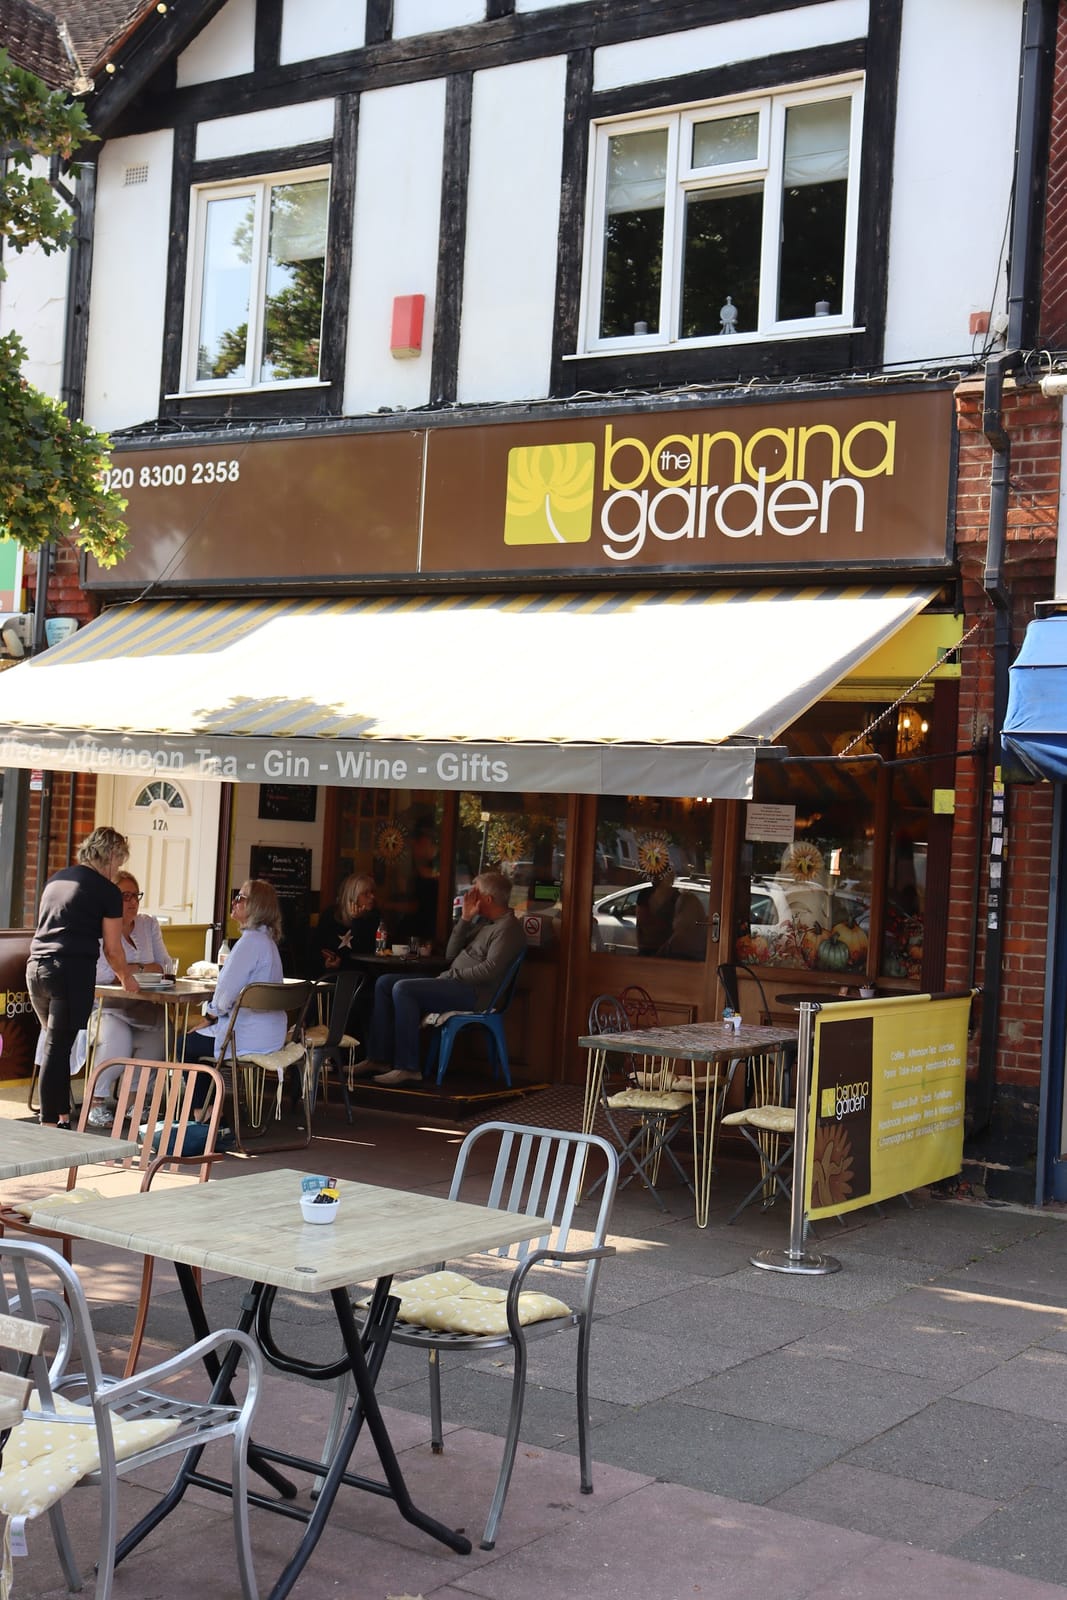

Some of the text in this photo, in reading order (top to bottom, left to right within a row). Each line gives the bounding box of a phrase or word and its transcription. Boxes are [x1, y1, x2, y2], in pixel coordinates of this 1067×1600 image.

[603, 420, 896, 490] banana
[660, 451, 690, 471] the
[139, 464, 186, 488] 8300
[192, 460, 240, 484] 2358
[601, 467, 865, 561] garden
[62, 739, 184, 771] Afternoon
[194, 748, 238, 776] Tea
[263, 750, 309, 778] Gin
[336, 751, 408, 781] Wine
[436, 752, 509, 783] Gifts
[153, 819, 168, 831] 17A
[836, 1081, 868, 1101] banana
[836, 1095, 865, 1120] garden
